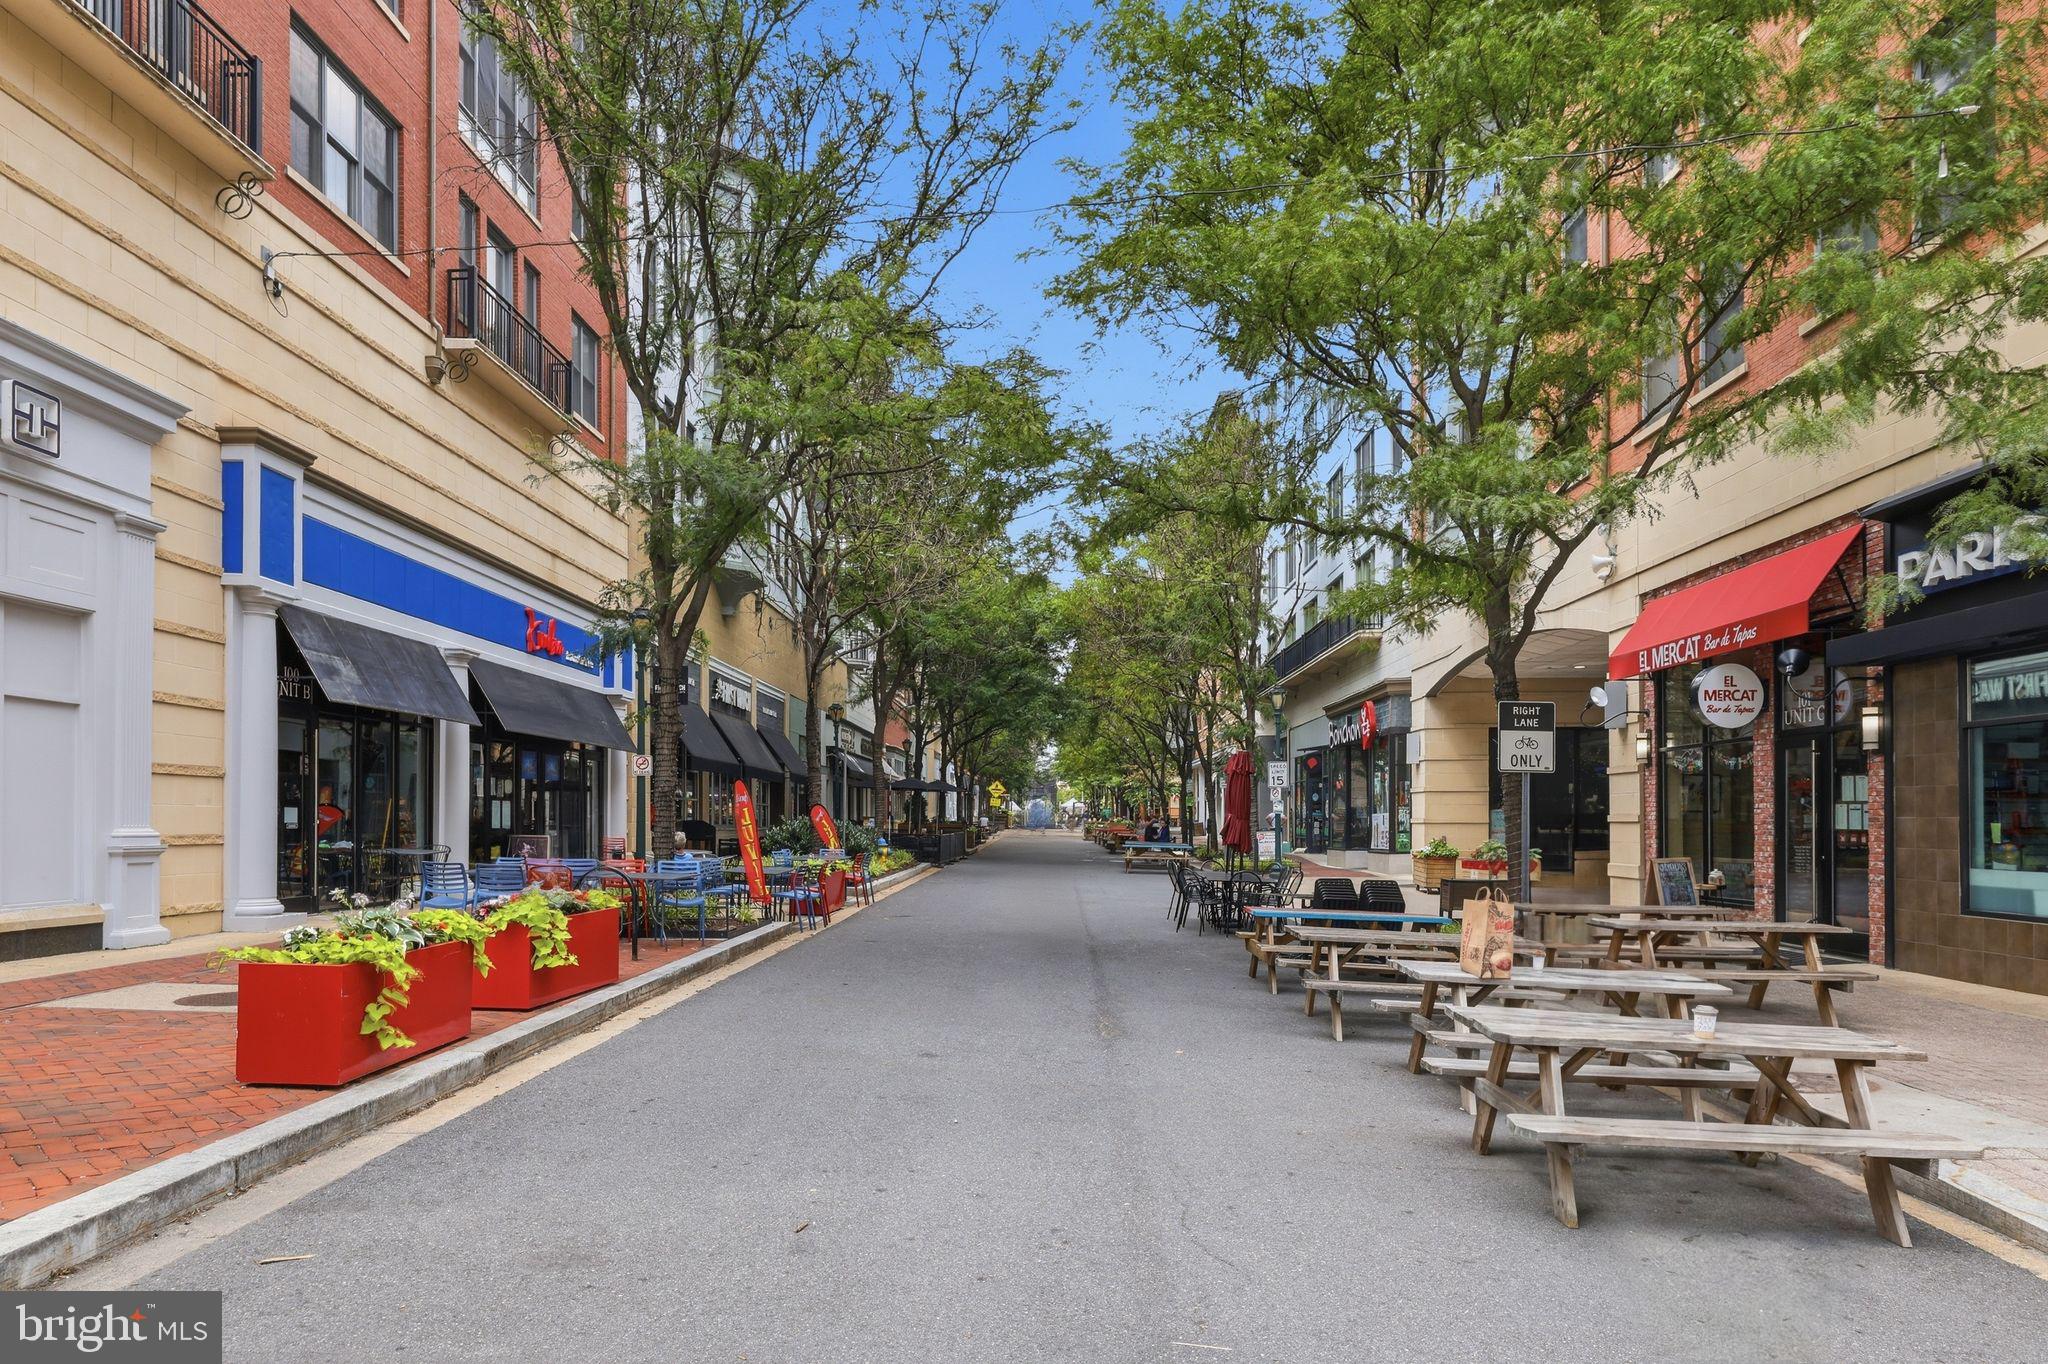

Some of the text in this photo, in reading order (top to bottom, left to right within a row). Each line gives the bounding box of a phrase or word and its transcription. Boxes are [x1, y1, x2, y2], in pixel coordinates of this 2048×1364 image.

[1639, 624, 1757, 672] EL MERCAT Bar de Tapas
[1723, 675, 1737, 687] EL
[279, 680, 311, 699] NIT B
[1703, 689, 1758, 702] MERCAT
[1513, 706, 1541, 715] RIGHT
[1706, 705, 1755, 716] Bar de Tapas
[1784, 705, 1825, 725] UNIT C
[1514, 718, 1539, 727] LANE
[1328, 715, 1361, 749] Bonchon
[1510, 754, 1543, 768] ONLY
[1271, 775, 1285, 786] 15
